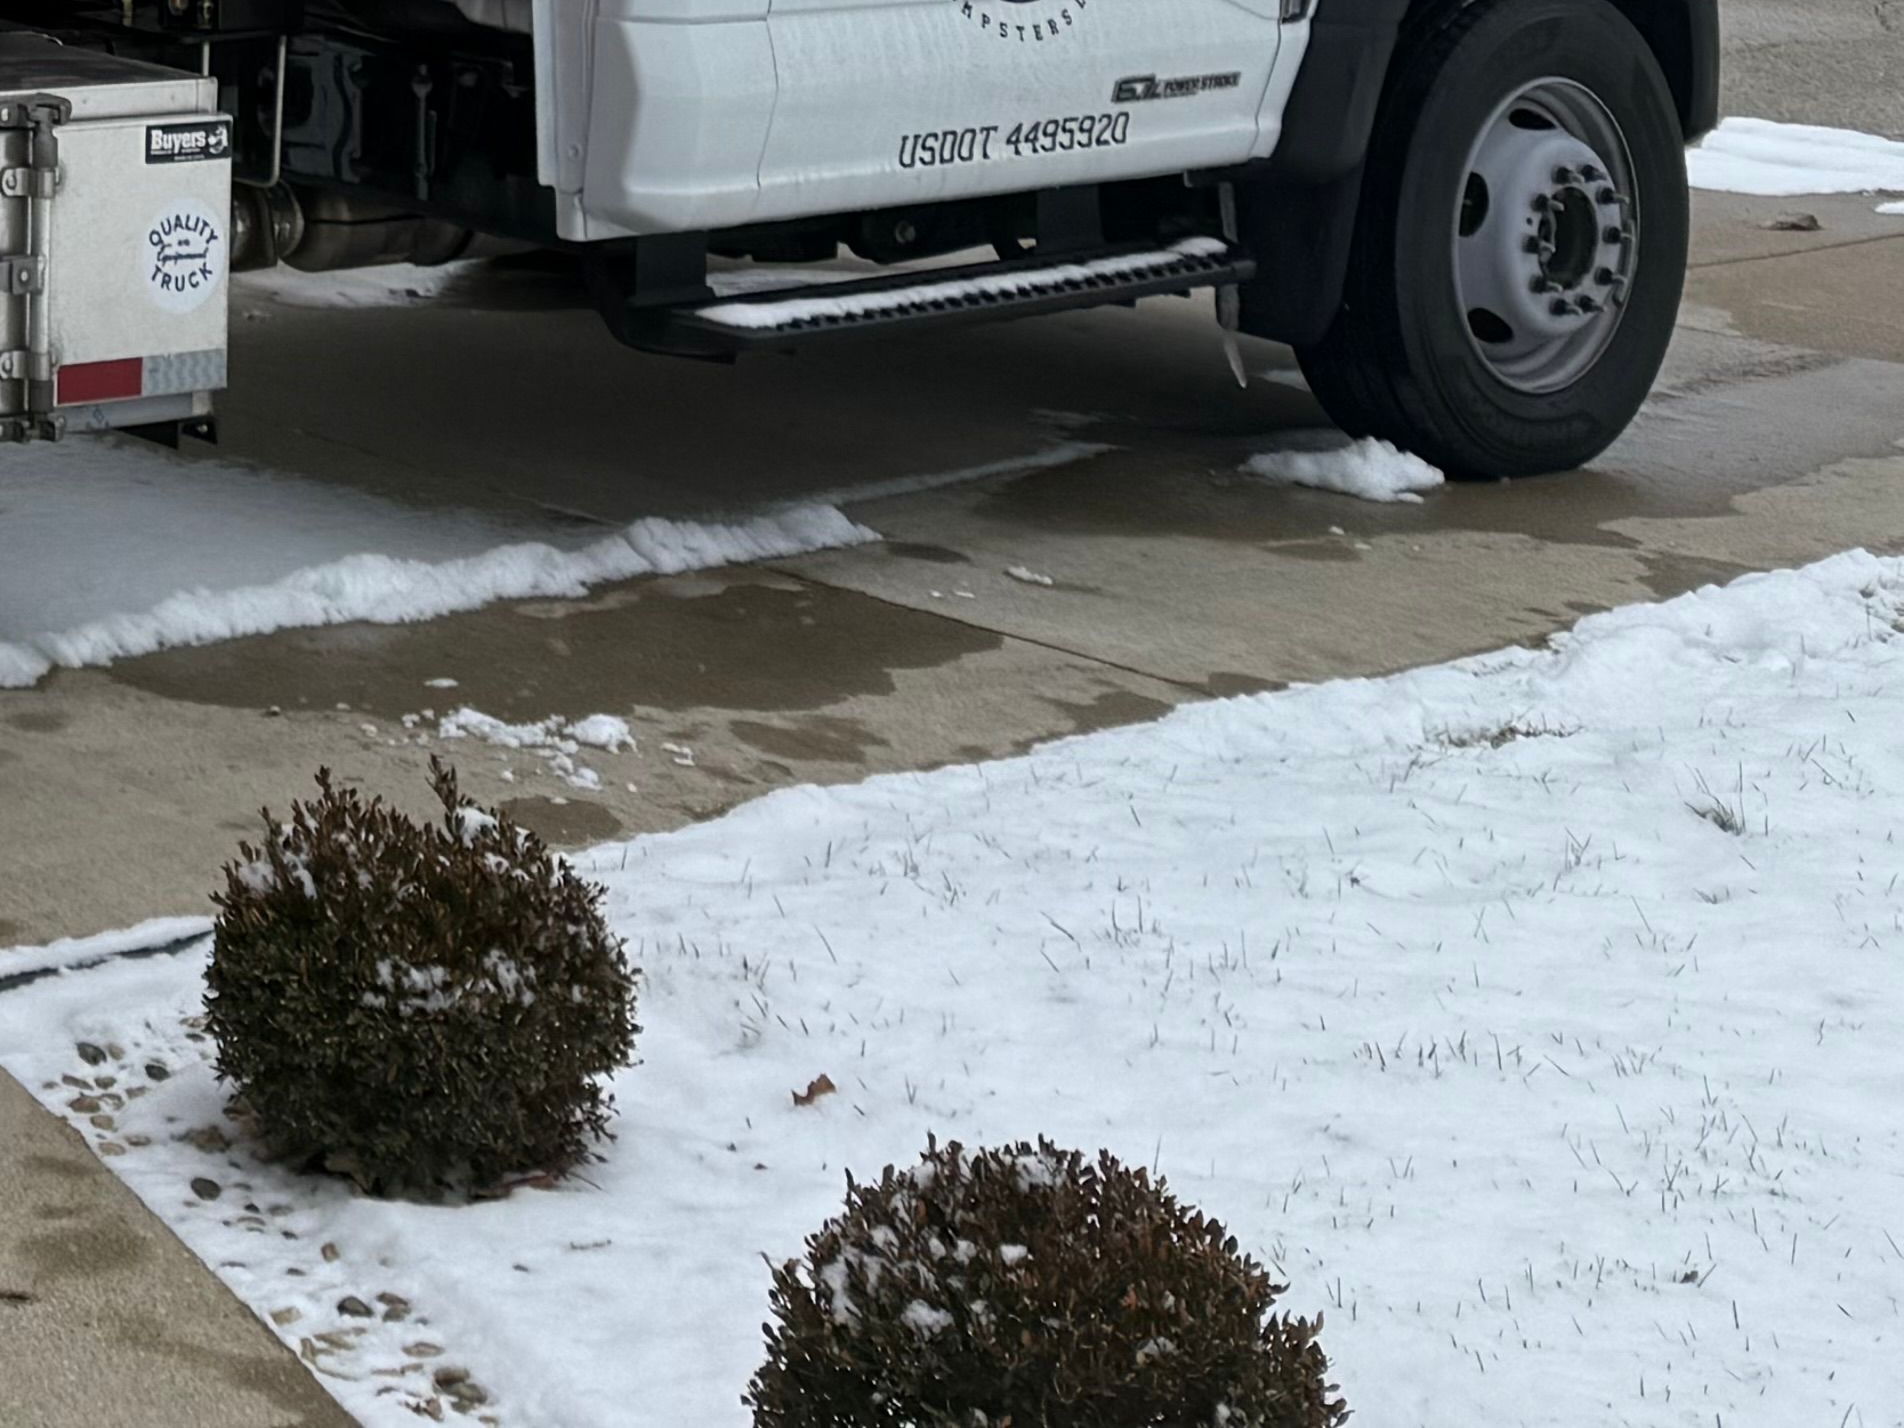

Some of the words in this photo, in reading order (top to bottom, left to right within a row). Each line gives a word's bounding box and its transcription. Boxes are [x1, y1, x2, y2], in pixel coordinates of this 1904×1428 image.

[150, 129, 207, 155] Buyers
[898, 124, 998, 170] USDOT
[1005, 111, 1131, 160] 4495920
[149, 213, 219, 247] QUALITY
[151, 261, 213, 293] TRUCK
